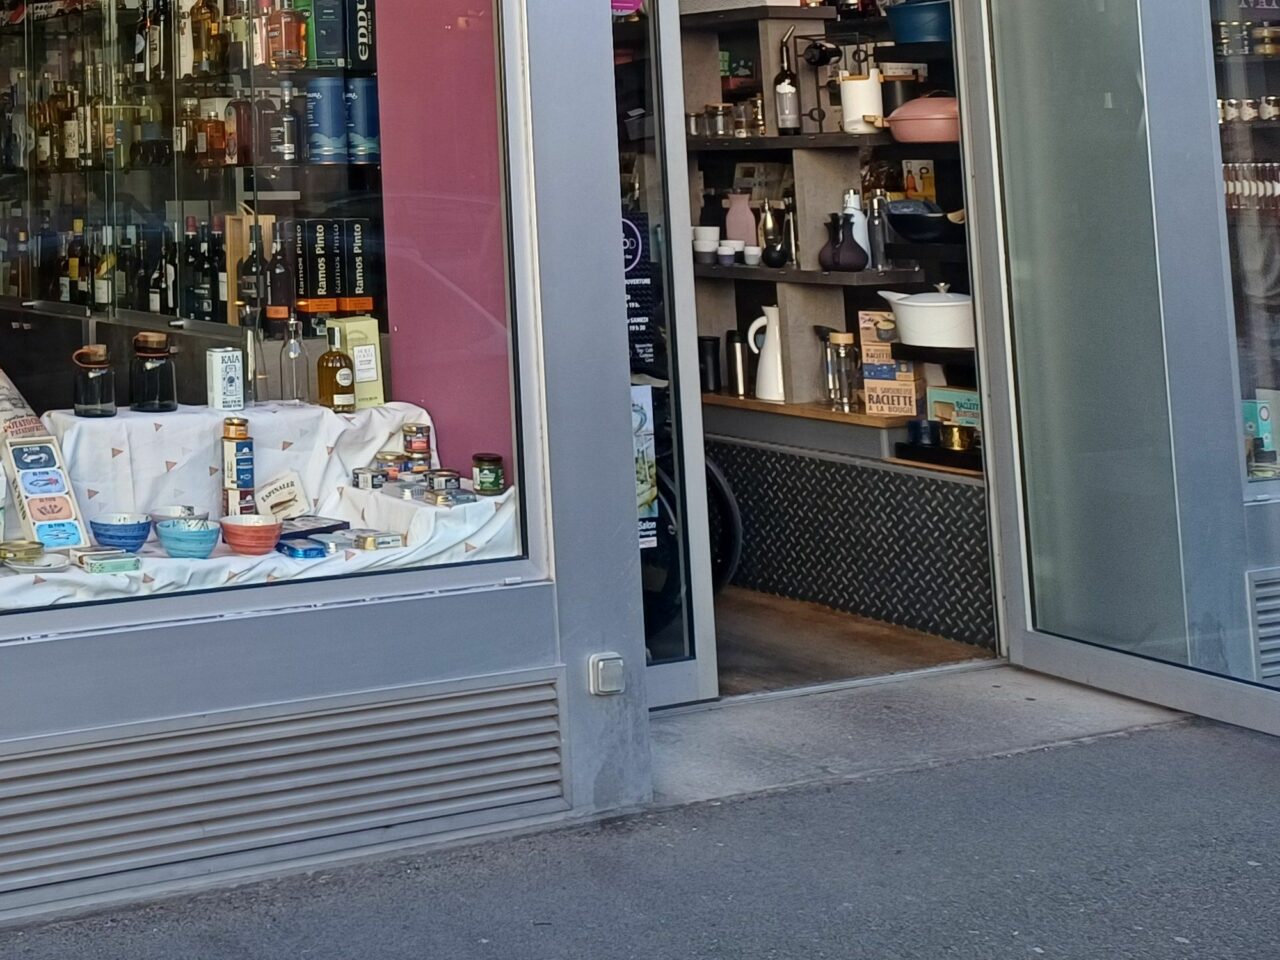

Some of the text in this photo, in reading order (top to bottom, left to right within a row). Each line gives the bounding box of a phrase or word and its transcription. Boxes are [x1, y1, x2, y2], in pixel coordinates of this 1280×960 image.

[315, 224, 327, 295] Ramos Pinto
[353, 224, 364, 295] Ramos Pinto
[868, 394, 913, 407] RACLETTE
